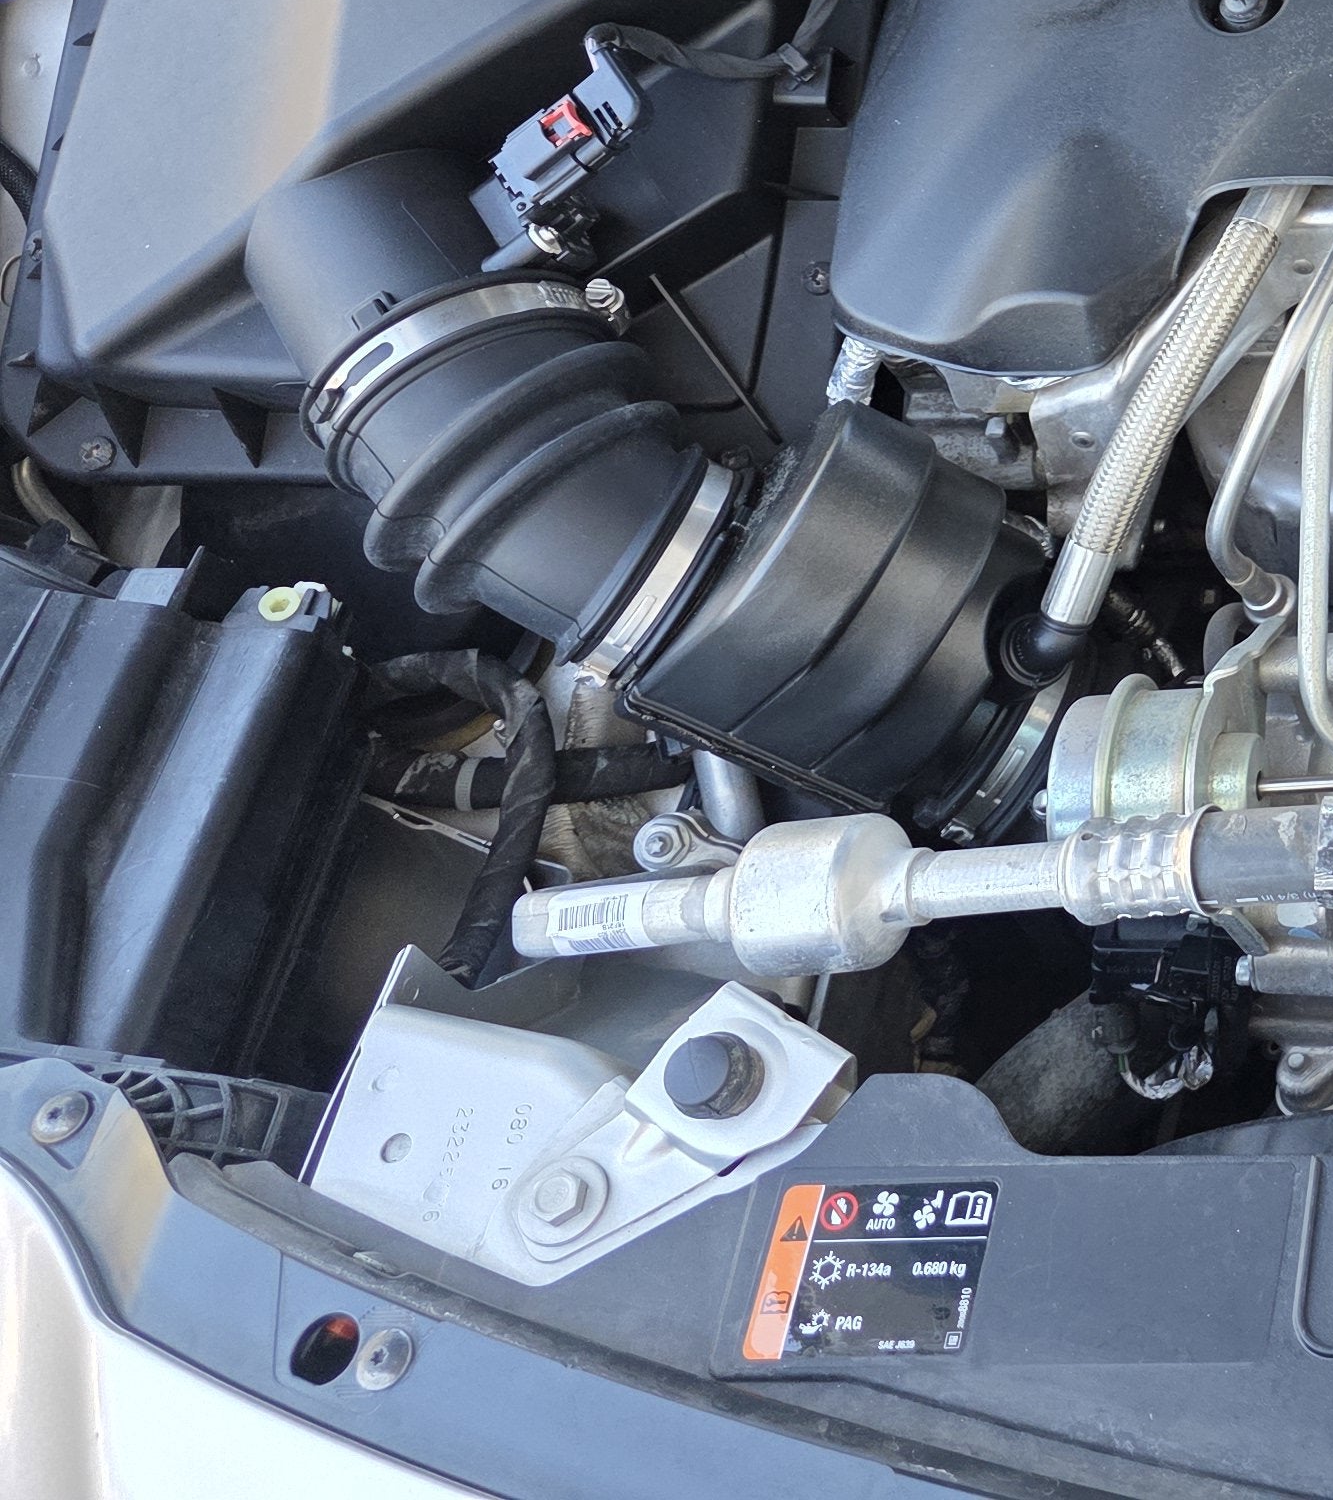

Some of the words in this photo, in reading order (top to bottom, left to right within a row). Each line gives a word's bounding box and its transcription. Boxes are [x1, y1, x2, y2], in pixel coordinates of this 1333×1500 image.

[506, 1103, 533, 1145] 080
[866, 1218, 896, 1230] AUTO
[846, 1262, 892, 1277] R-134a
[912, 1261, 947, 1277] 0.680
[949, 1261, 967, 1279] kg
[834, 1315, 863, 1331] PAG
[878, 1340, 895, 1350] SAE
